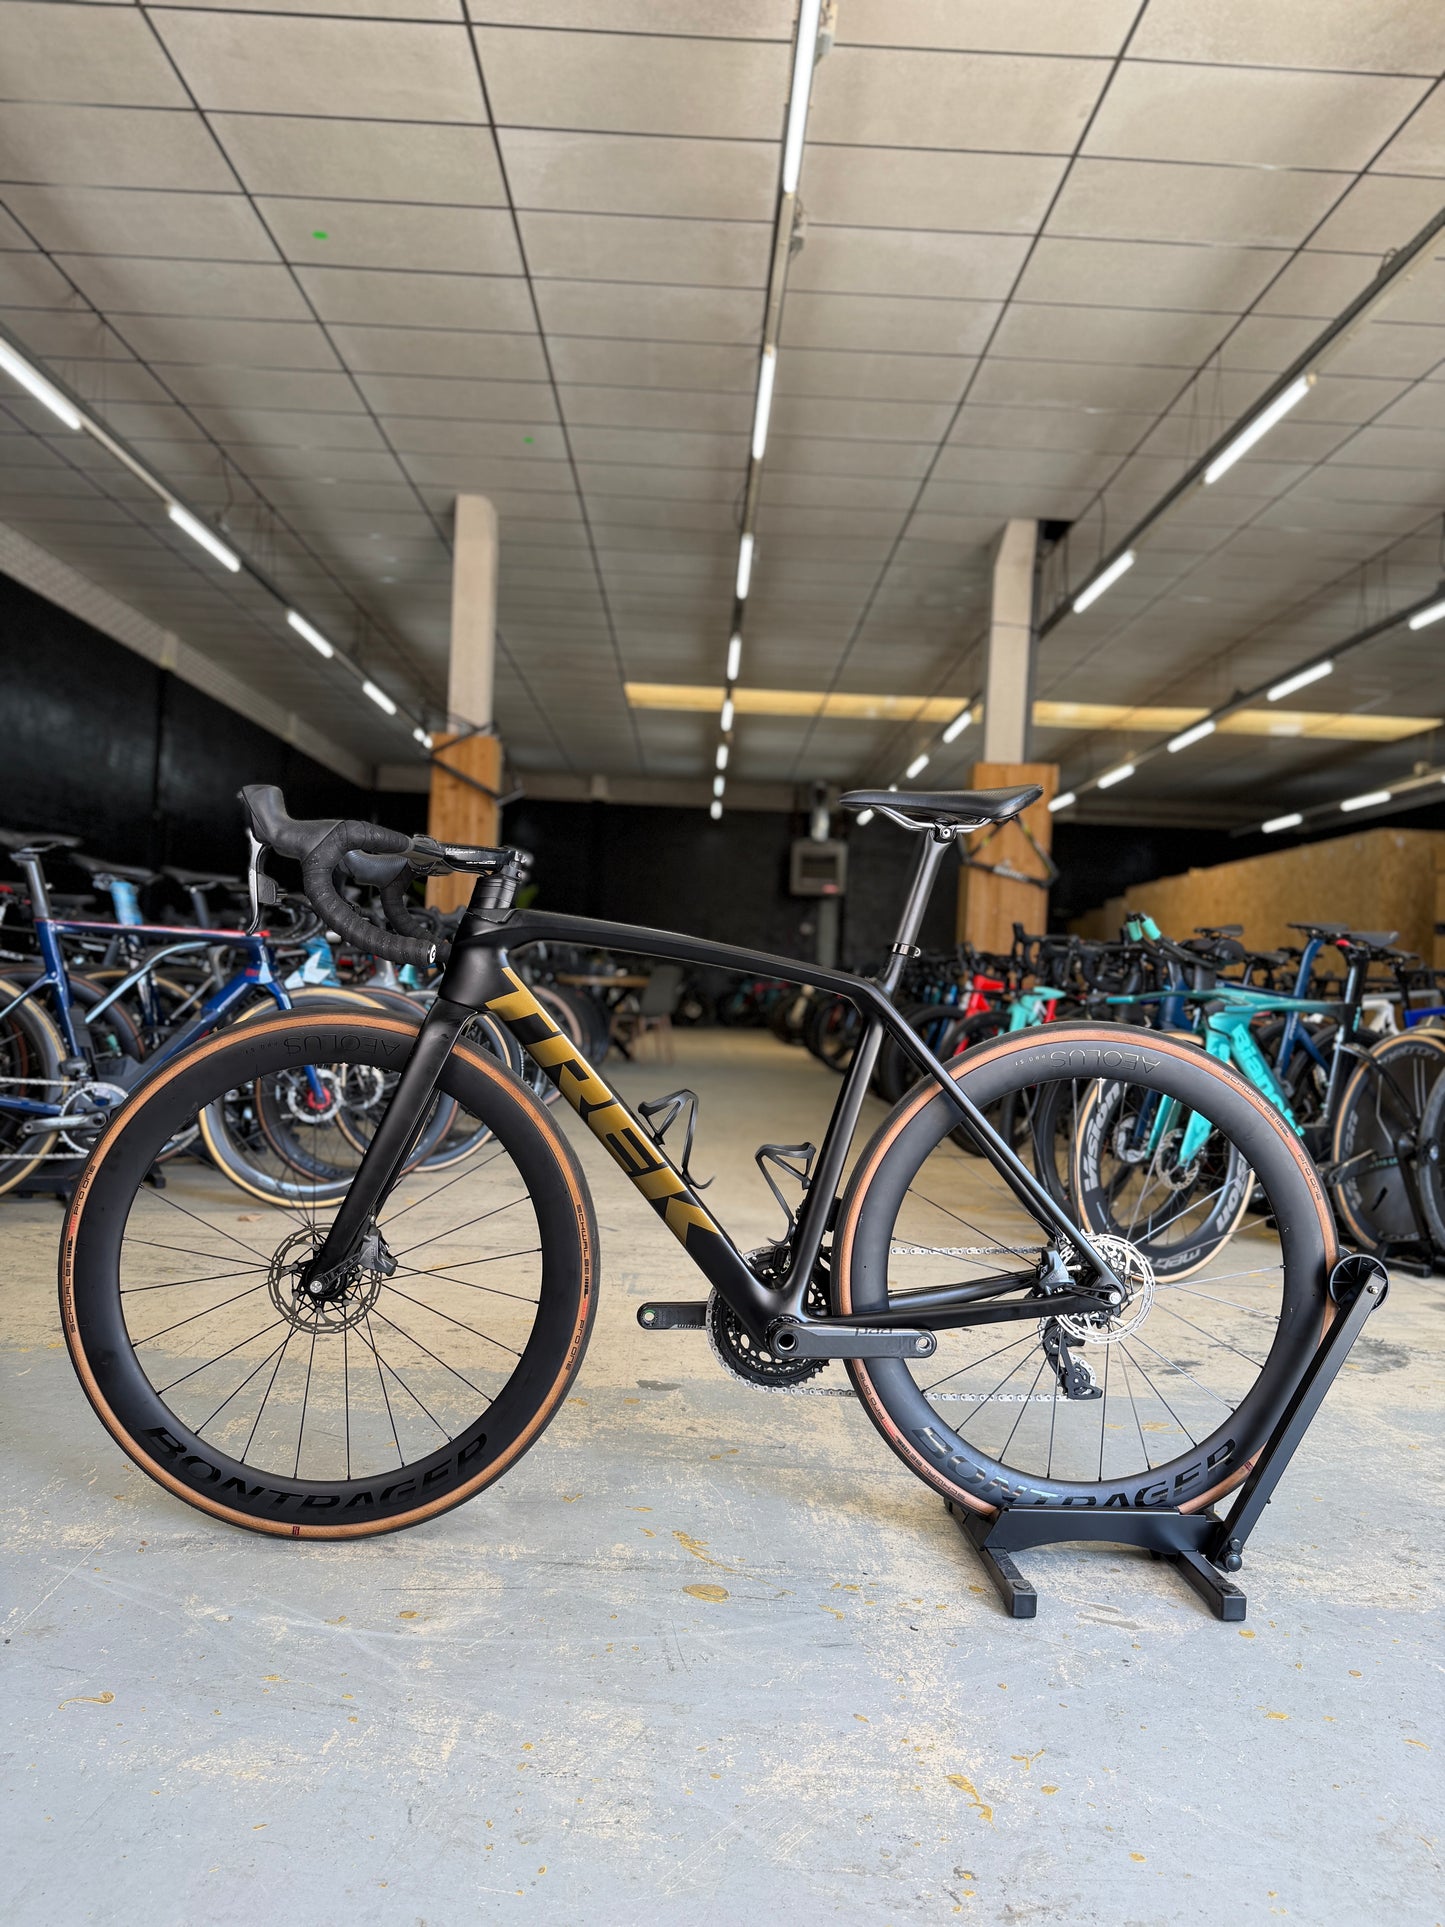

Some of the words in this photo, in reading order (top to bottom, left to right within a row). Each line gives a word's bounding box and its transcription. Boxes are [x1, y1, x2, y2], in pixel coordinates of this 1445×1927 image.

[283, 1034, 401, 1057] AEOLUS
[1050, 1049, 1161, 1074] AEOLUS
[485, 967, 720, 1248] TREK
[1223, 1071, 1277, 1121] SCHWALBE
[576, 1203, 590, 1275] SCHWALBE
[64, 1260, 77, 1334] SCHWALBE
[138, 1426, 488, 1511] BONTRAGER
[909, 1453, 966, 1501] SCHWALBE
